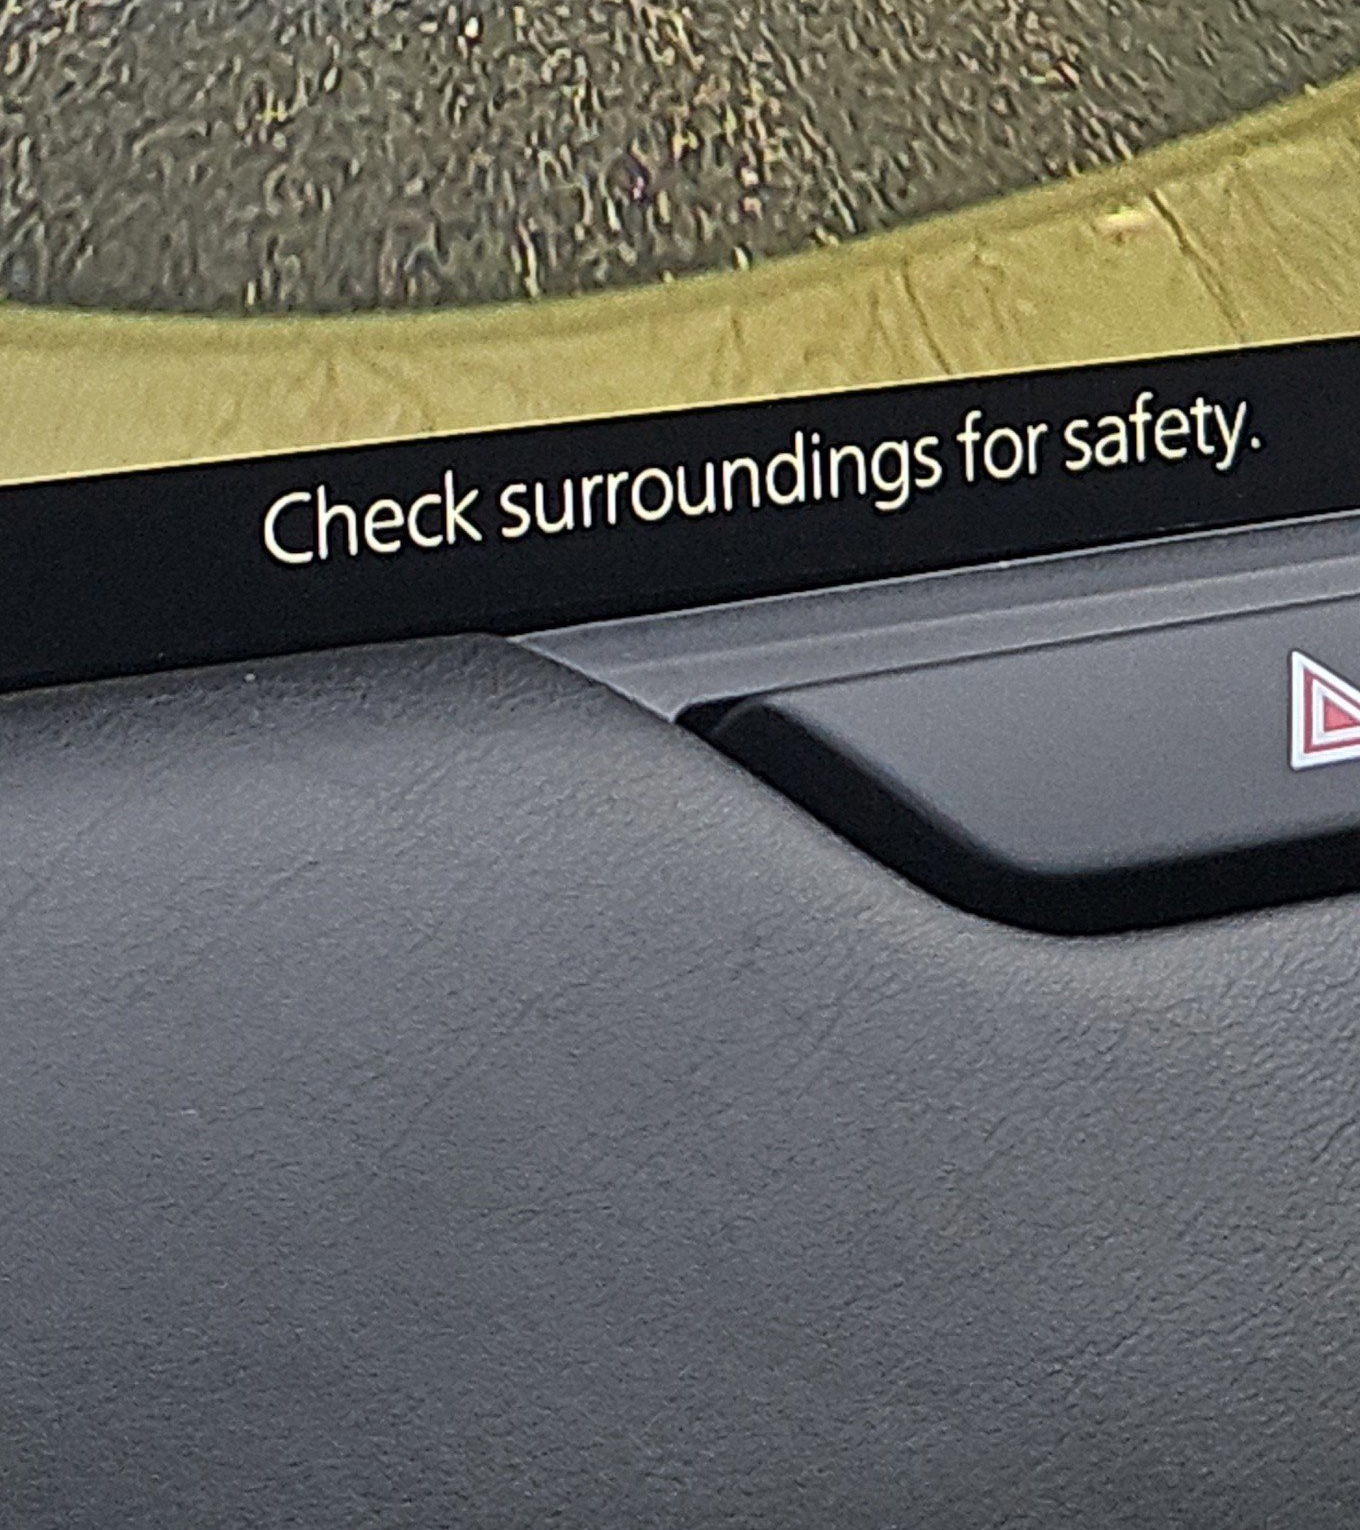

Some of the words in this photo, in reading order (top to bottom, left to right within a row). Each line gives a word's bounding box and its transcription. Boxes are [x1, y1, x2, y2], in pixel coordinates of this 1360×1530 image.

[262, 468, 484, 565] Check
[498, 429, 944, 539] surroundings
[955, 409, 1050, 482] for
[1063, 391, 1262, 472] safety.
